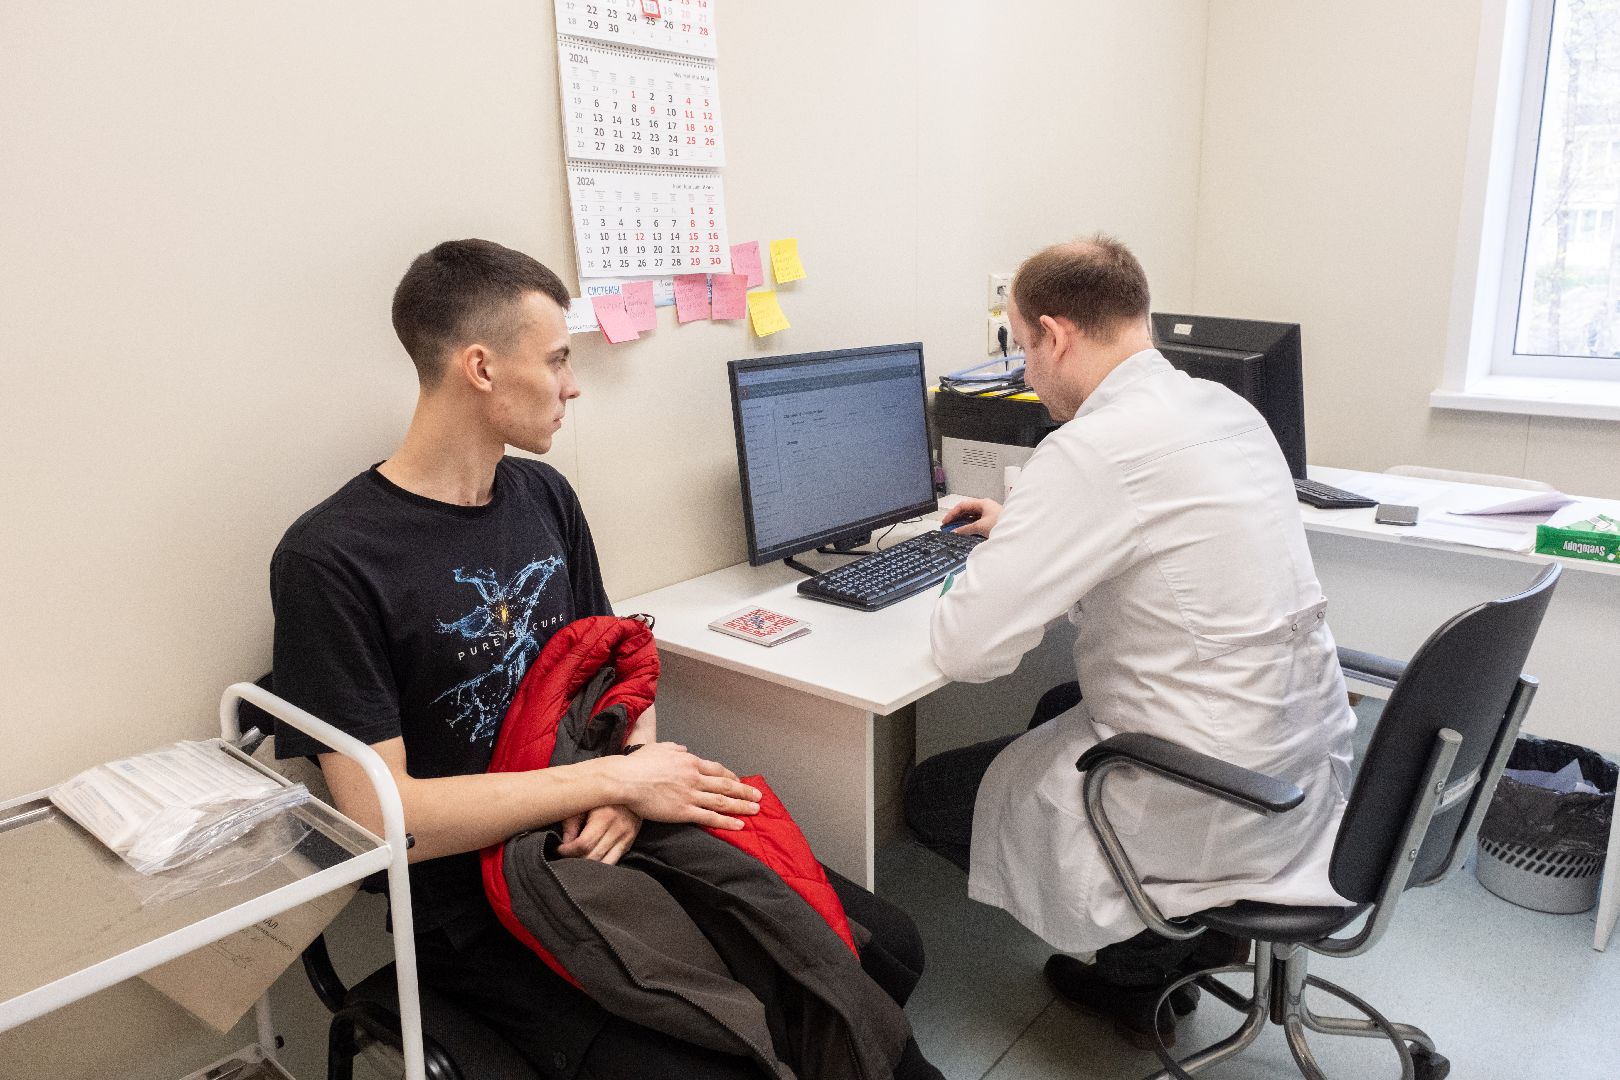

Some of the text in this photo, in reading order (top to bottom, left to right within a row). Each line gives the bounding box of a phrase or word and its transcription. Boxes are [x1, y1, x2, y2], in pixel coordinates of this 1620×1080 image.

[587, 5, 597, 14] 22
[608, 9, 618, 18] 23
[627, 13, 637, 22] 24
[646, 18, 655, 26] 25
[664, 20, 673, 29] 26
[682, 24, 691, 32] 27
[699, 27, 708, 35] 28
[588, 20, 598, 29] 29
[609, 24, 619, 32] 30
[569, 53, 588, 64] 2024
[667, 108, 676, 116] 10
[593, 114, 603, 122] 13
[613, 116, 622, 124] 14
[631, 118, 640, 126] 15
[649, 120, 658, 128] 16
[594, 128, 604, 136] 20
[614, 130, 623, 138] 21
[632, 132, 641, 140] 22
[650, 134, 659, 142] 23
[669, 135, 678, 143] 24
[705, 138, 714, 146] 26
[595, 142, 605, 151] 27
[615, 144, 624, 152] 28
[633, 145, 642, 154] 29
[651, 147, 660, 155] 30
[577, 177, 595, 186] 2024
[619, 246, 628, 254] 18
[603, 260, 611, 268] 24
[587, 285, 620, 296] СИСТЕМЫ
[1563, 541, 1605, 556] SvetoCopy
[458, 638, 501, 660] PURE
[532, 614, 564, 632] CURE
[263, 918, 279, 930] АЛ
